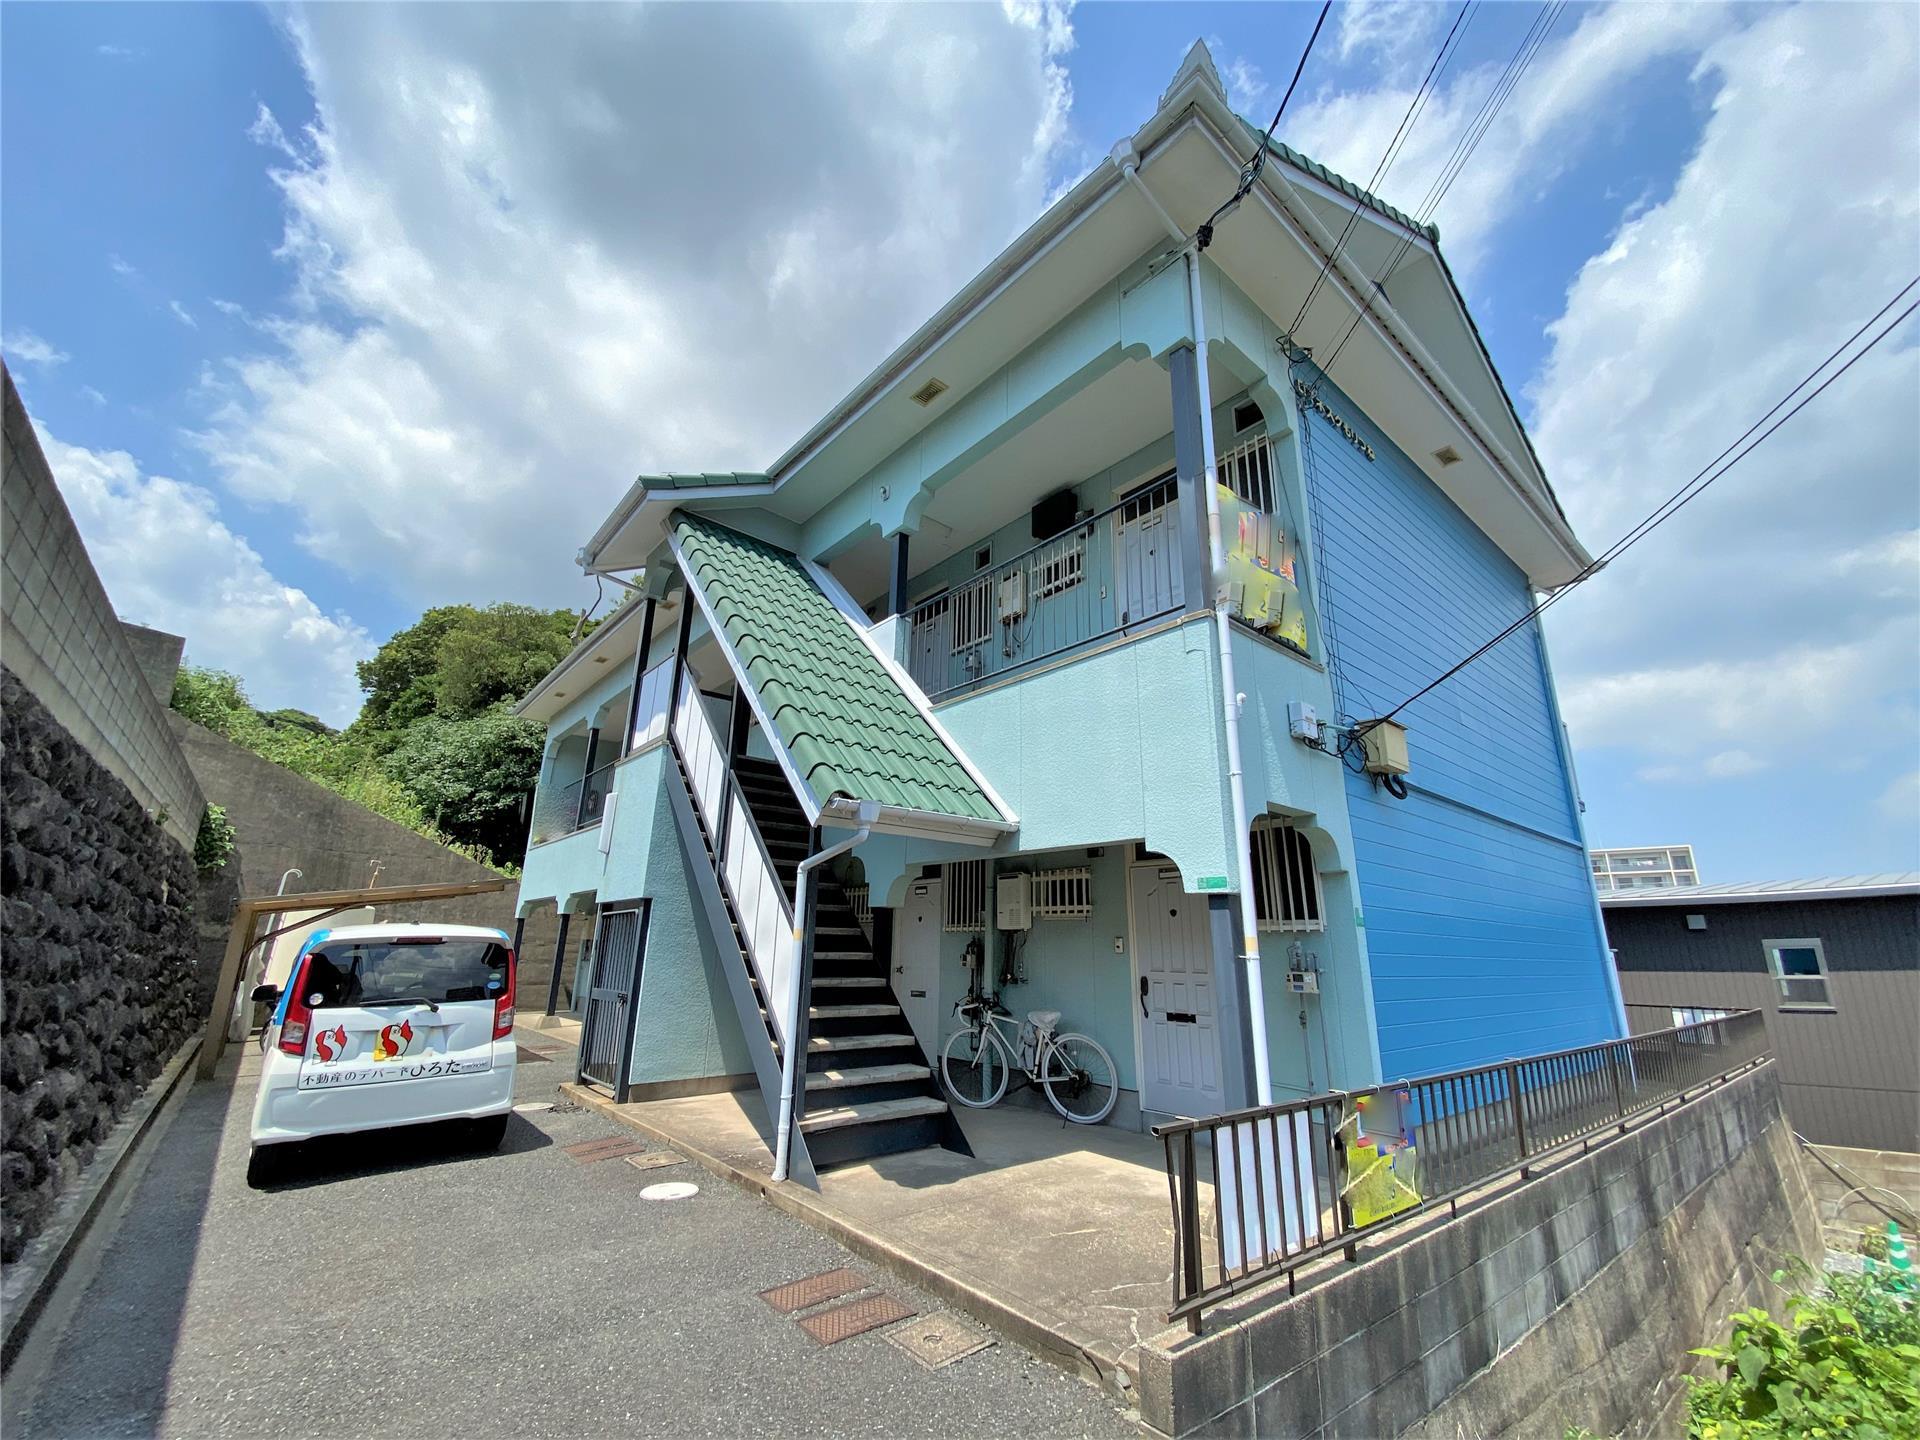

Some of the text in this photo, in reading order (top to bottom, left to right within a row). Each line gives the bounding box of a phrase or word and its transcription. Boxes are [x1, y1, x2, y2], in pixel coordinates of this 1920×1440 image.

[1296, 378, 1376, 461] ロネスクもりつね
